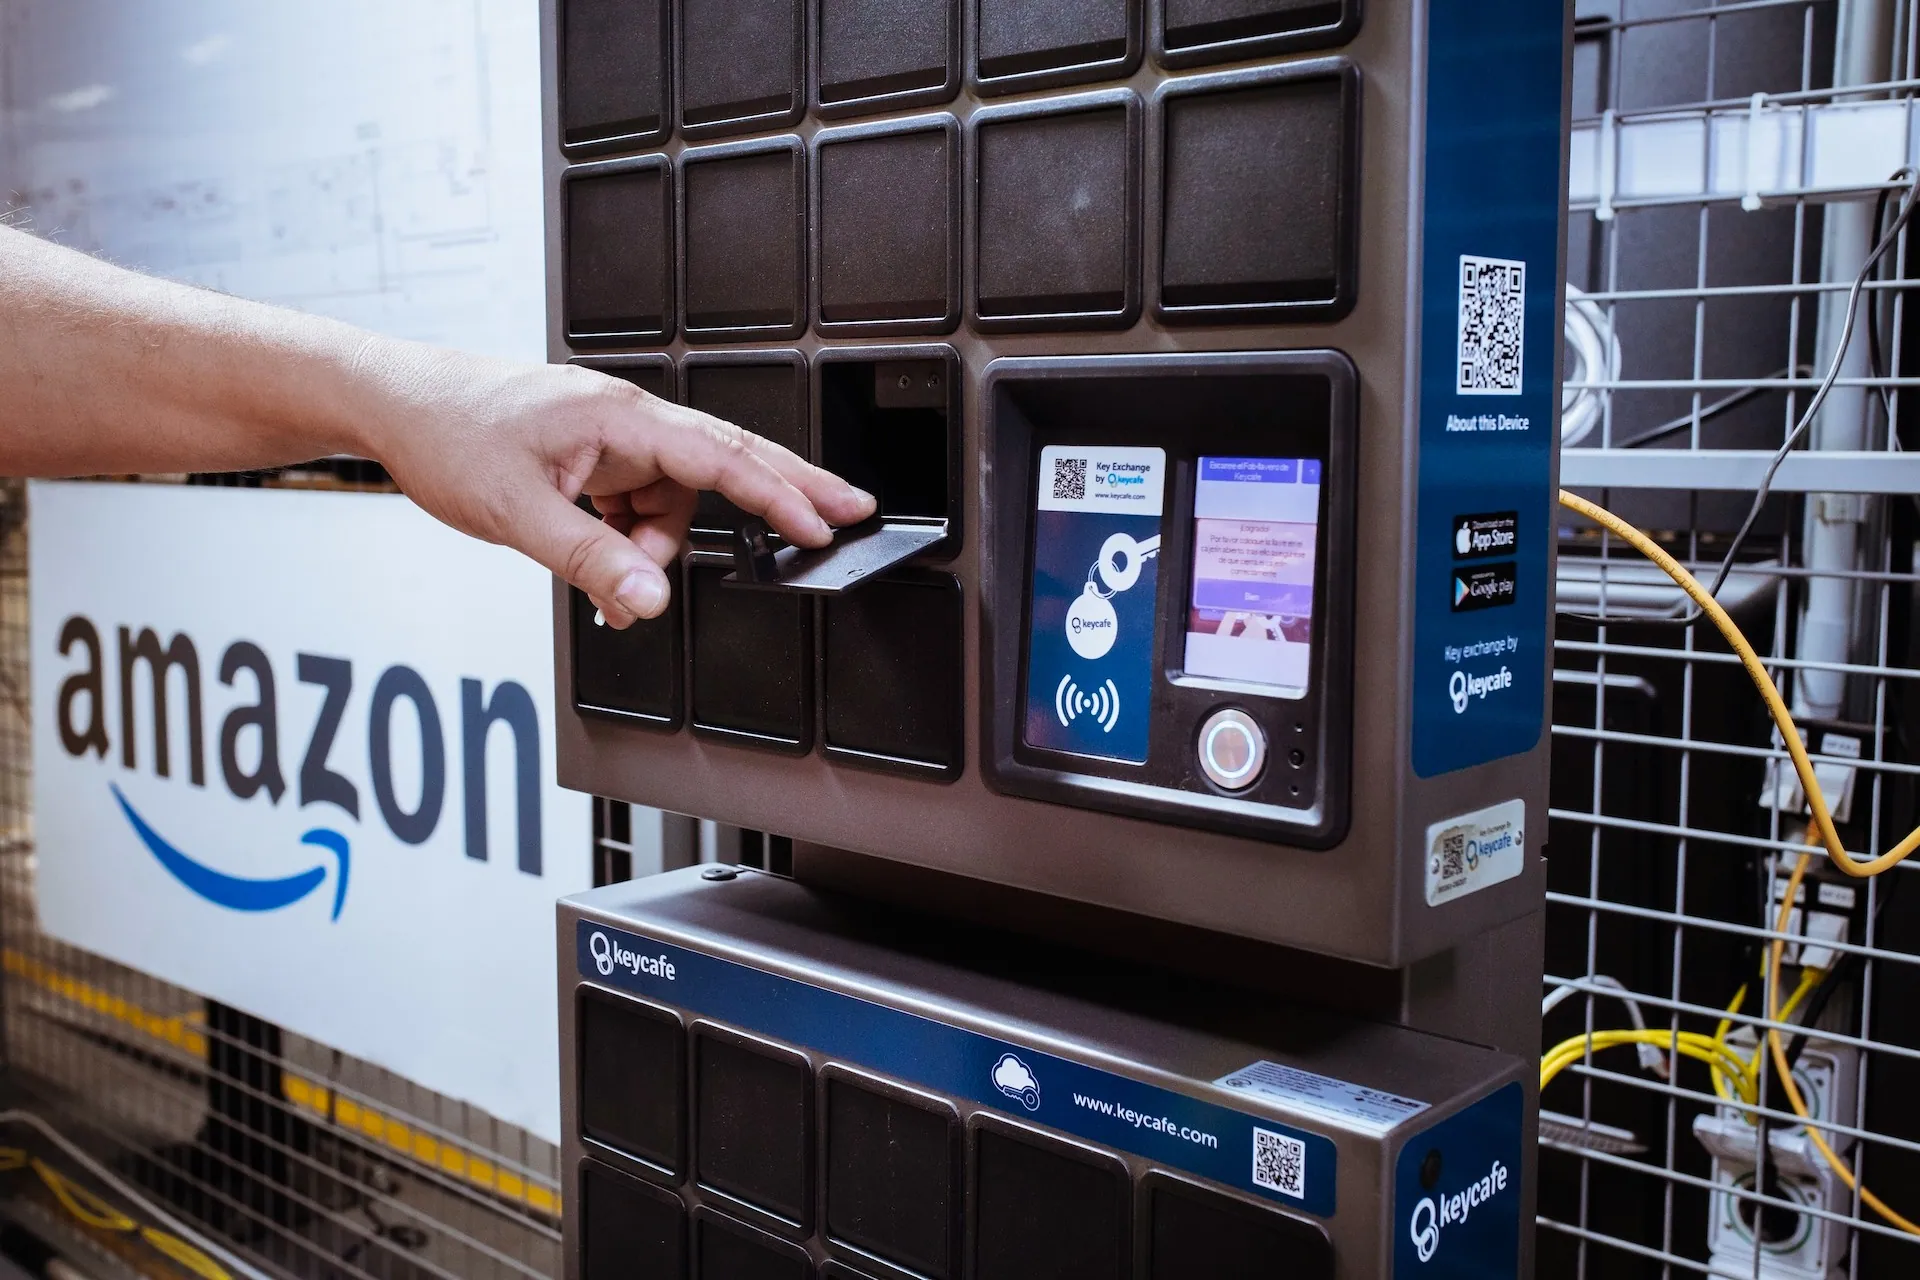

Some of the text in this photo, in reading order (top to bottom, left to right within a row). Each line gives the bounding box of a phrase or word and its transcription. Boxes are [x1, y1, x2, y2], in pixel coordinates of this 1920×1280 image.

[1446, 414, 1529, 432] About this Device
[1095, 474, 1144, 486] by keycafe
[1096, 462, 1151, 473] Key Exchange
[1094, 492, 1146, 500] www.keycafe.com
[1472, 528, 1514, 552] App Store
[1470, 577, 1514, 599] Google play
[1082, 617, 1112, 631] keycafe
[1444, 635, 1519, 664] Key exchange by
[1467, 665, 1513, 700] keycafe
[57, 613, 543, 878] amazon
[1479, 832, 1512, 859] keycafe
[613, 940, 676, 981] keycafe
[1073, 1092, 1218, 1149] www.keycafe.com
[1439, 1160, 1508, 1228] keycafe
